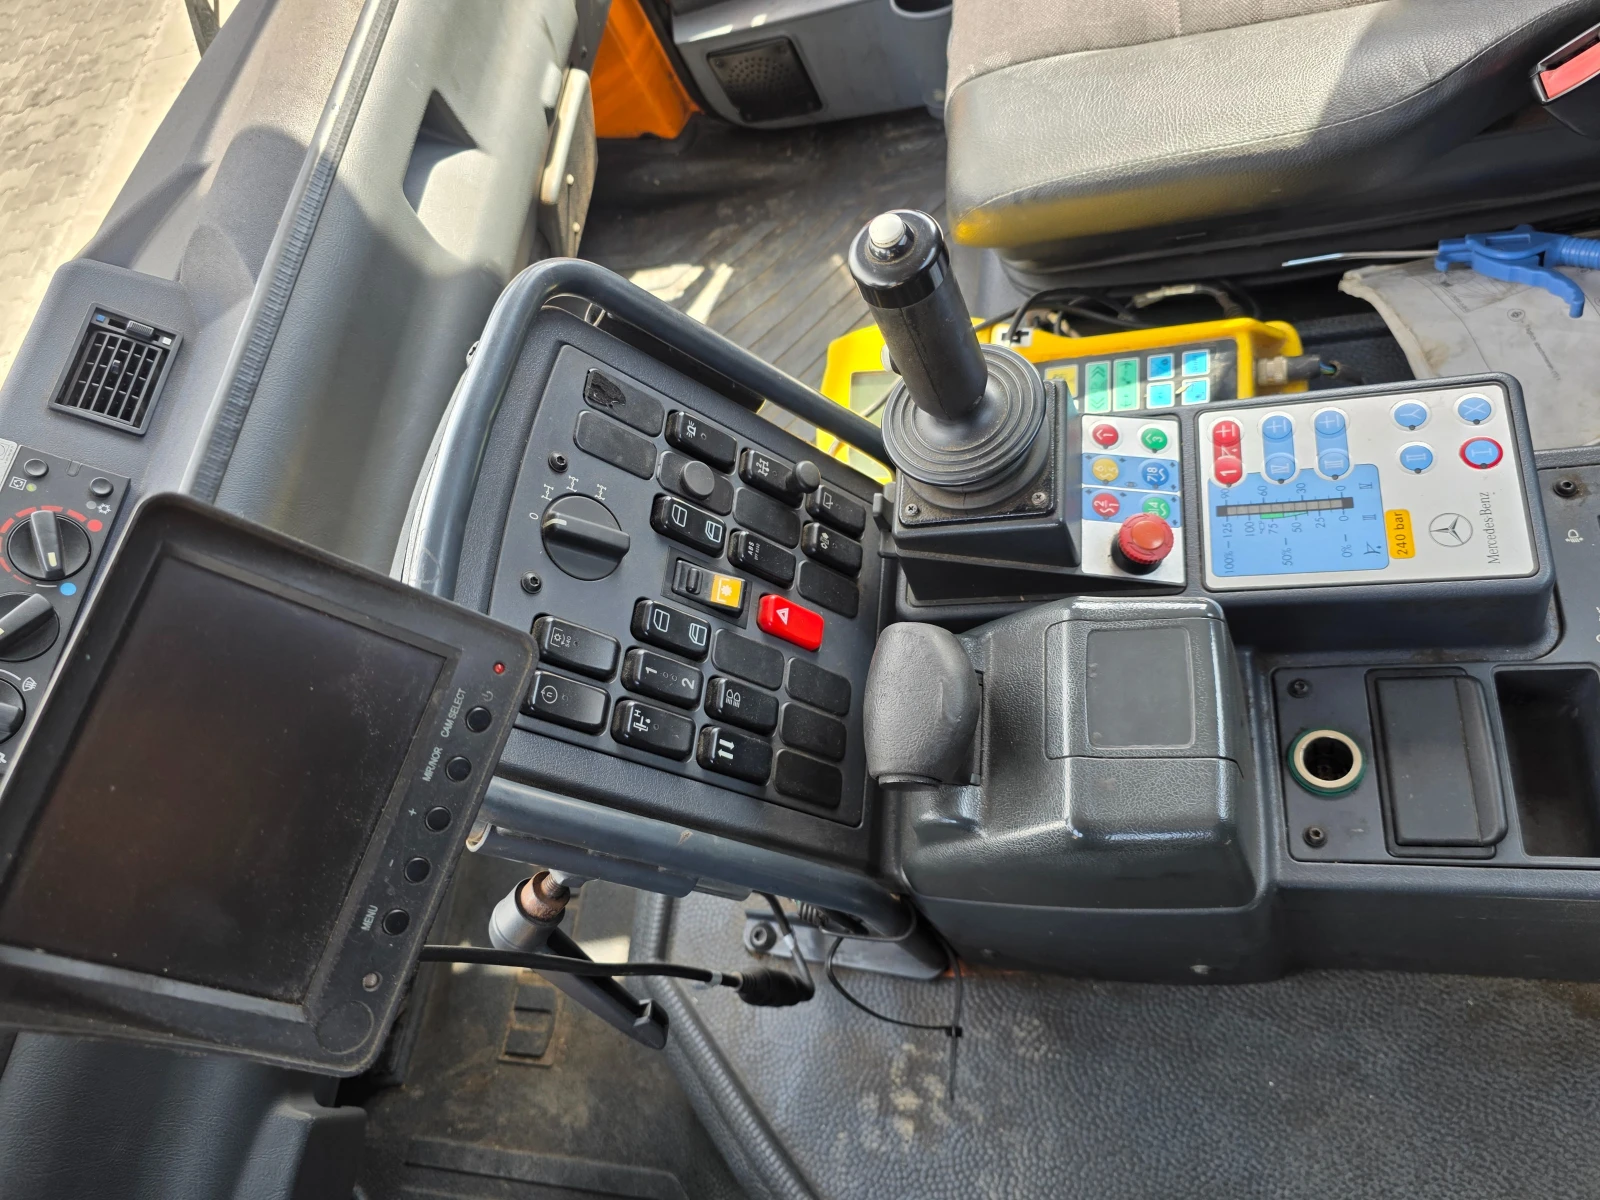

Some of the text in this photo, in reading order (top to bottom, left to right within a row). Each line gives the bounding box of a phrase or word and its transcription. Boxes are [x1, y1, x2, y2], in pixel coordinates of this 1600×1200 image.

[1258, 485, 1268, 496] 60
[1296, 482, 1306, 494] 30
[1223, 522, 1232, 538] 125
[1245, 521, 1254, 537] 100
[1268, 522, 1277, 534] 75
[1292, 522, 1302, 533] 50
[1315, 517, 1325, 529] 25
[1394, 512, 1408, 555] 240 bar
[1282, 547, 1293, 566] 50%
[1342, 544, 1352, 558] 0%
[1224, 550, 1235, 574] 100%
[681, 677, 695, 689] 2
[440, 688, 466, 738] CAM SELECT
[422, 746, 443, 782] MIR/NOR
[361, 905, 378, 931] MENU
